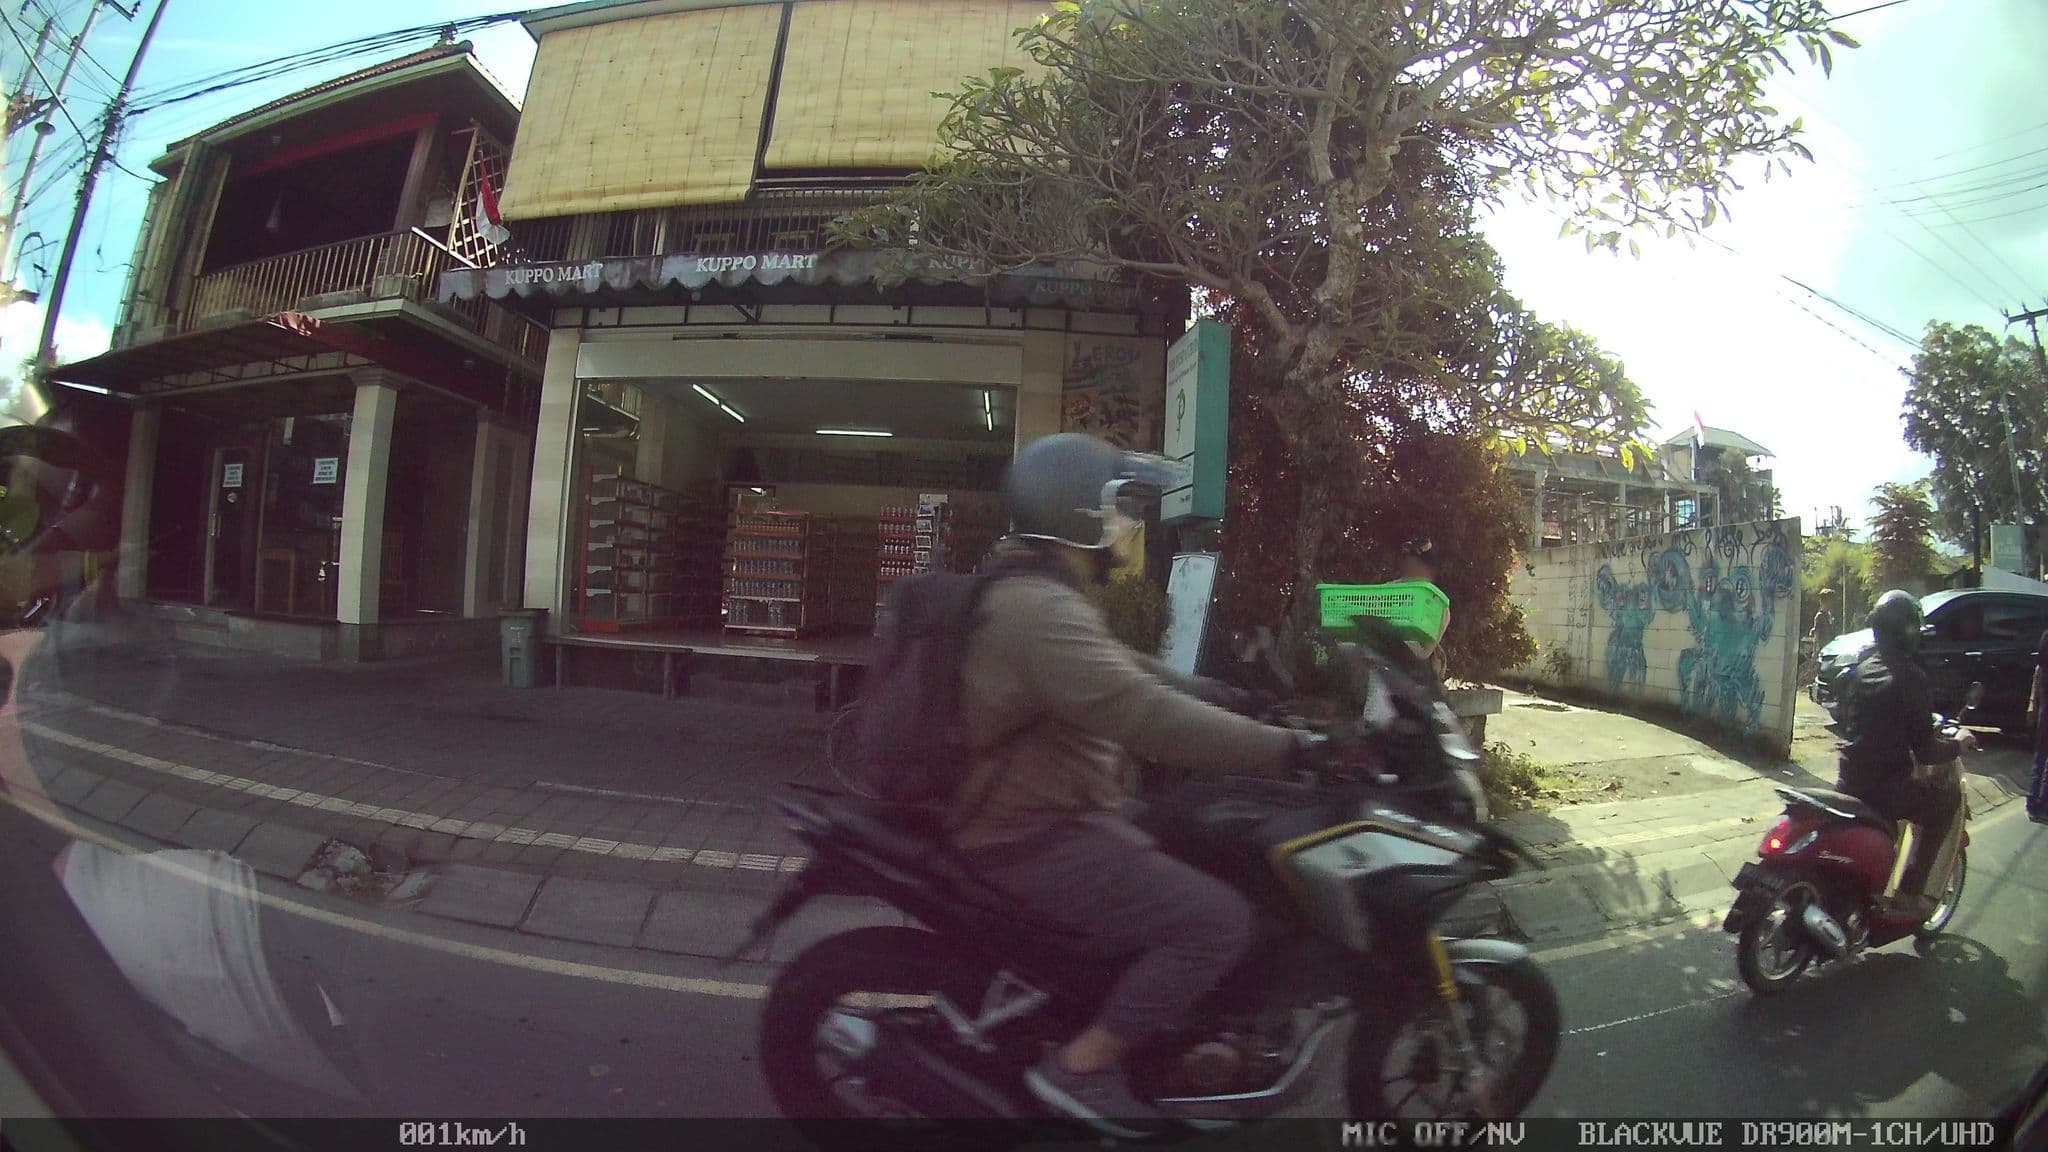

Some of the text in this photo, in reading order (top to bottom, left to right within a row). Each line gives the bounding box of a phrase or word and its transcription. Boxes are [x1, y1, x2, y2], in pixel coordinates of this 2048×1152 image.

[696, 253, 818, 273] KUPPO MART
[928, 254, 985, 270] KUPP
[505, 262, 604, 285] KUPPO MART
